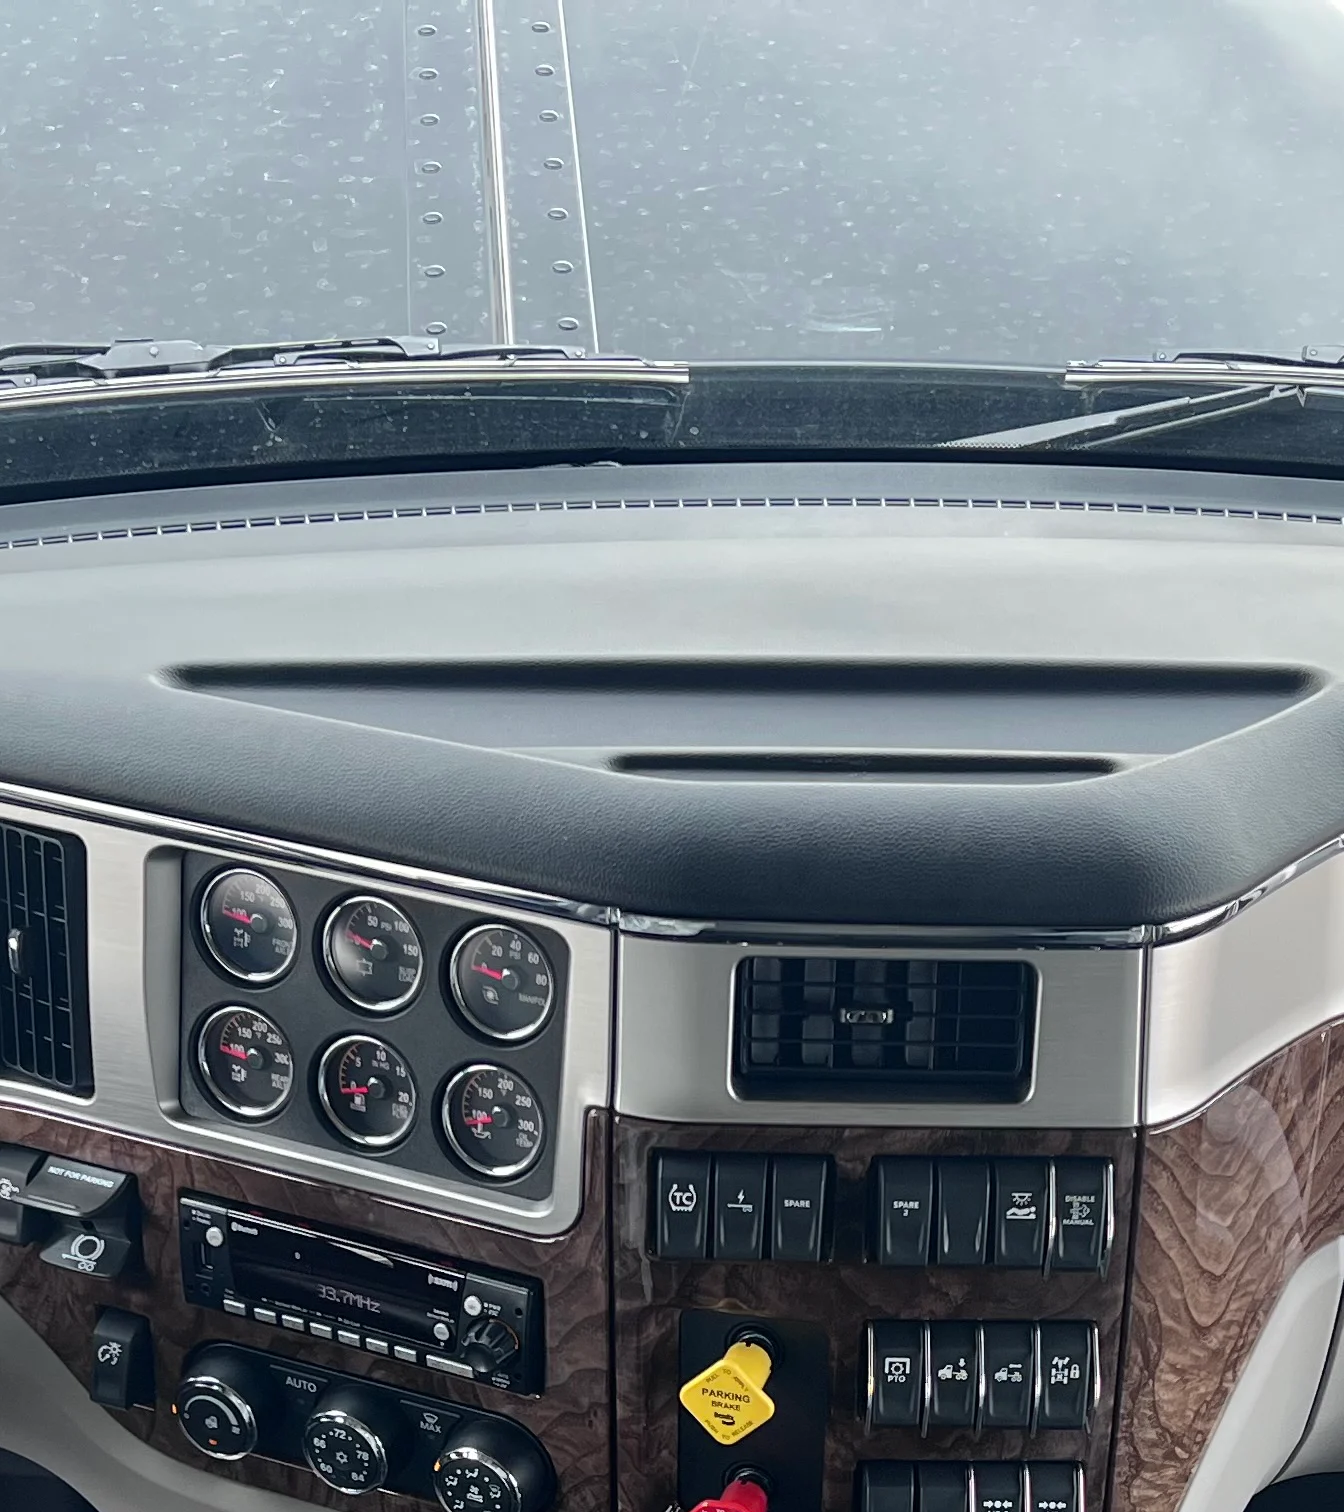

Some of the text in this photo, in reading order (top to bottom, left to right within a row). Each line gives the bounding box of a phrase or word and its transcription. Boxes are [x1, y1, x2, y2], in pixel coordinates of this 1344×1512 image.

[240, 891, 255, 903] 150
[367, 915, 378, 928] 50
[394, 920, 410, 933] 100
[403, 943, 419, 957] 150
[491, 944, 503, 957] 20
[509, 940, 522, 952] 40
[527, 951, 540, 965] 60
[535, 973, 548, 987] 80
[237, 1027, 253, 1039] 150
[252, 1020, 268, 1033] 200
[266, 1032, 283, 1046] 250
[376, 1050, 387, 1062] 10
[395, 1065, 407, 1078] 15
[497, 1078, 514, 1092] 200
[398, 1090, 410, 1104] 20
[477, 1087, 494, 1100] 150
[515, 1094, 532, 1108] 250
[517, 1119, 535, 1133] 300
[783, 1199, 811, 1209] SPARE
[893, 1200, 920, 1210] SPARE
[285, 1375, 318, 1393] AUTO
[887, 1375, 907, 1384] PTO
[701, 1387, 751, 1404] PARKING
[711, 1400, 741, 1412] BRAKE
[419, 1420, 442, 1434] MAX
[333, 1428, 348, 1440] 72
[355, 1449, 370, 1462] 78
[351, 1471, 365, 1483] 84
